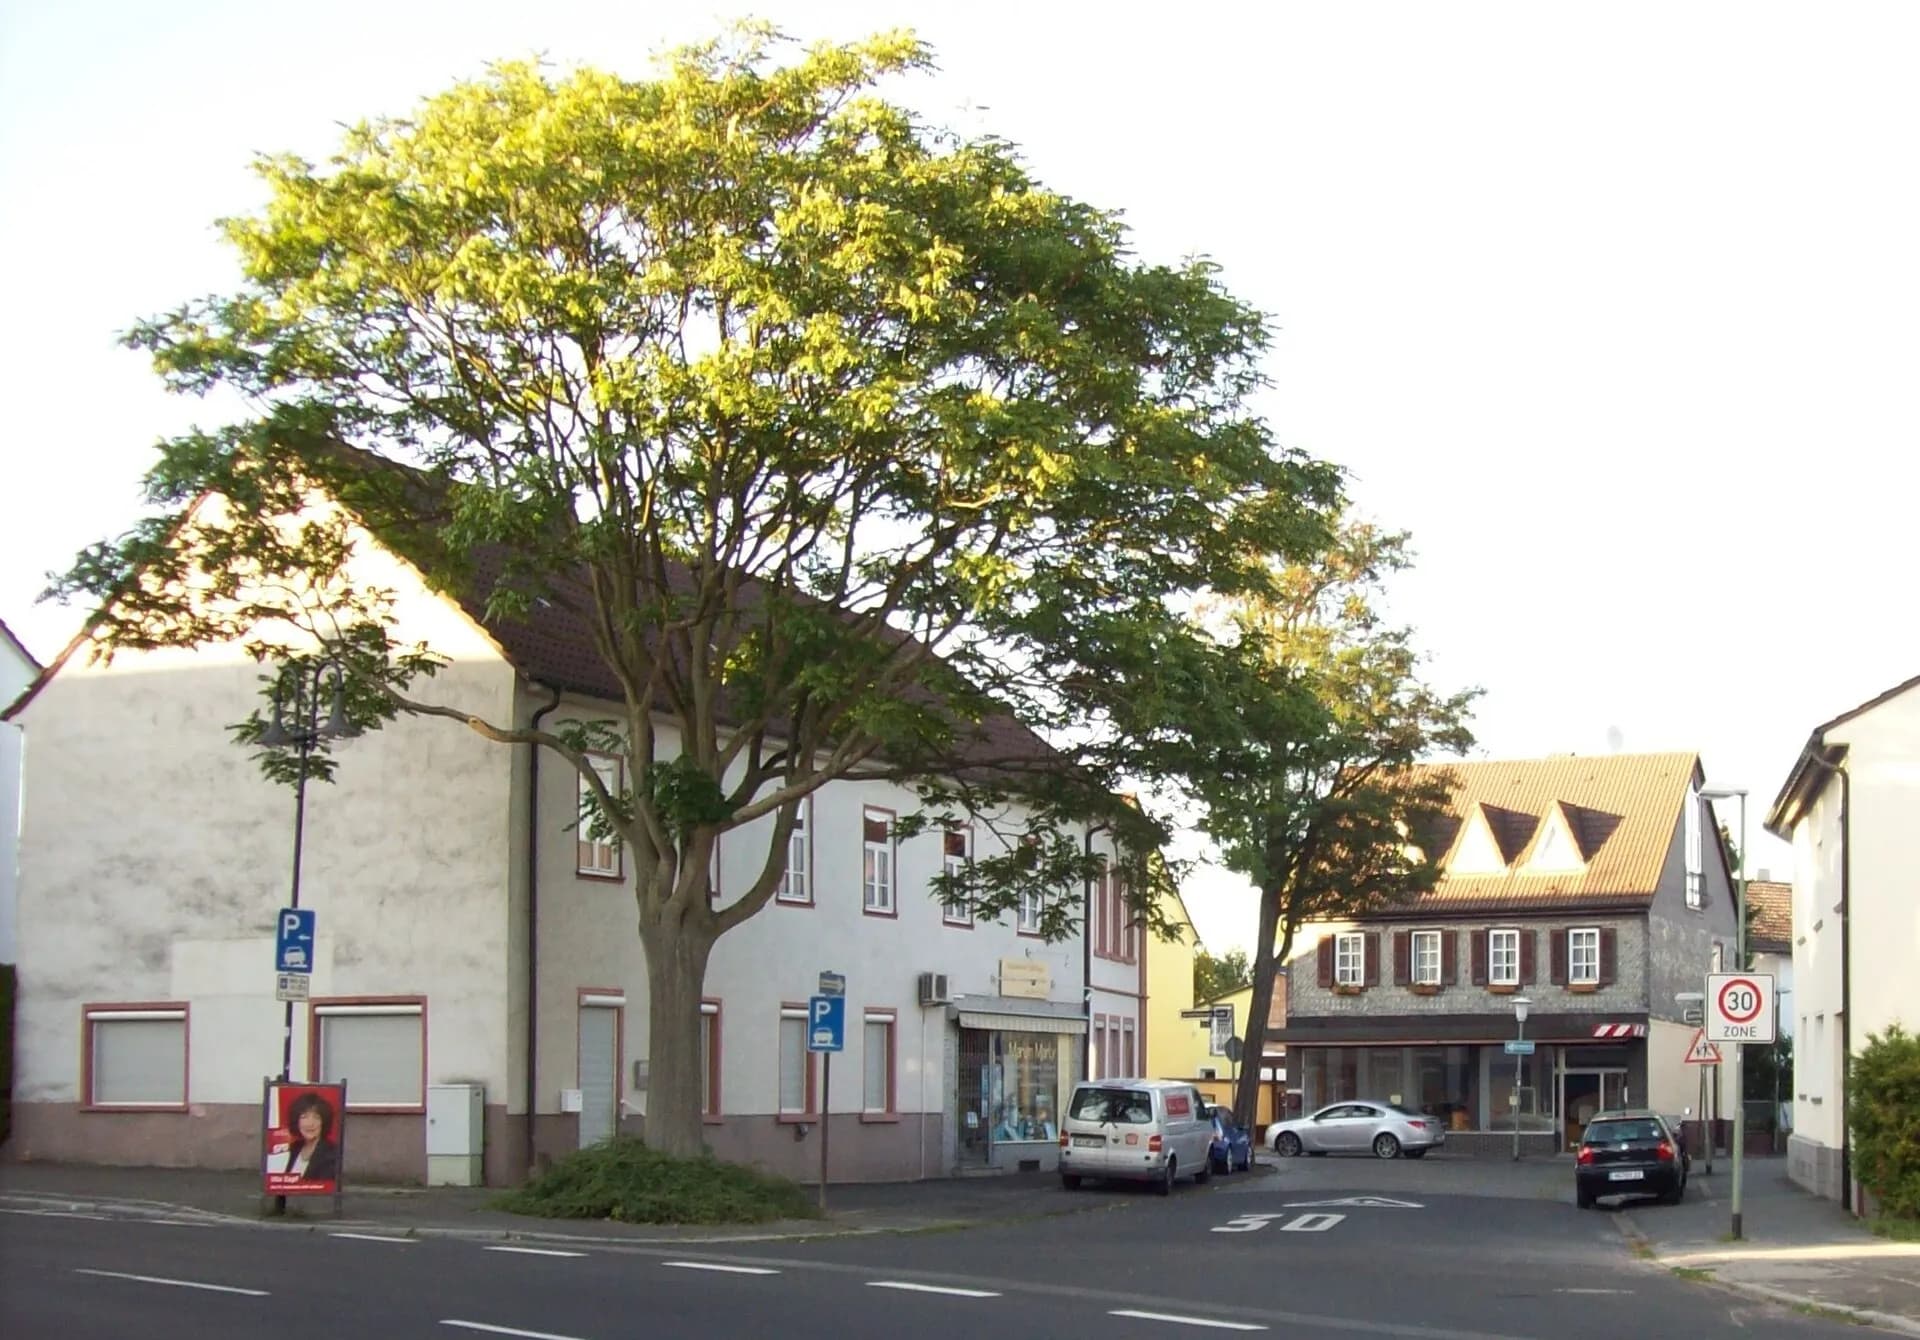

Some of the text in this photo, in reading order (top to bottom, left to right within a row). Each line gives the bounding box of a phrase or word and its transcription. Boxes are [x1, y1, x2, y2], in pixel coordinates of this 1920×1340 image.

[283, 914, 301, 940] P
[1727, 991, 1753, 1012] 30
[815, 1001, 831, 1024] P
[1723, 1026, 1757, 1038] ZONE
[1210, 1213, 1347, 1232] 30
